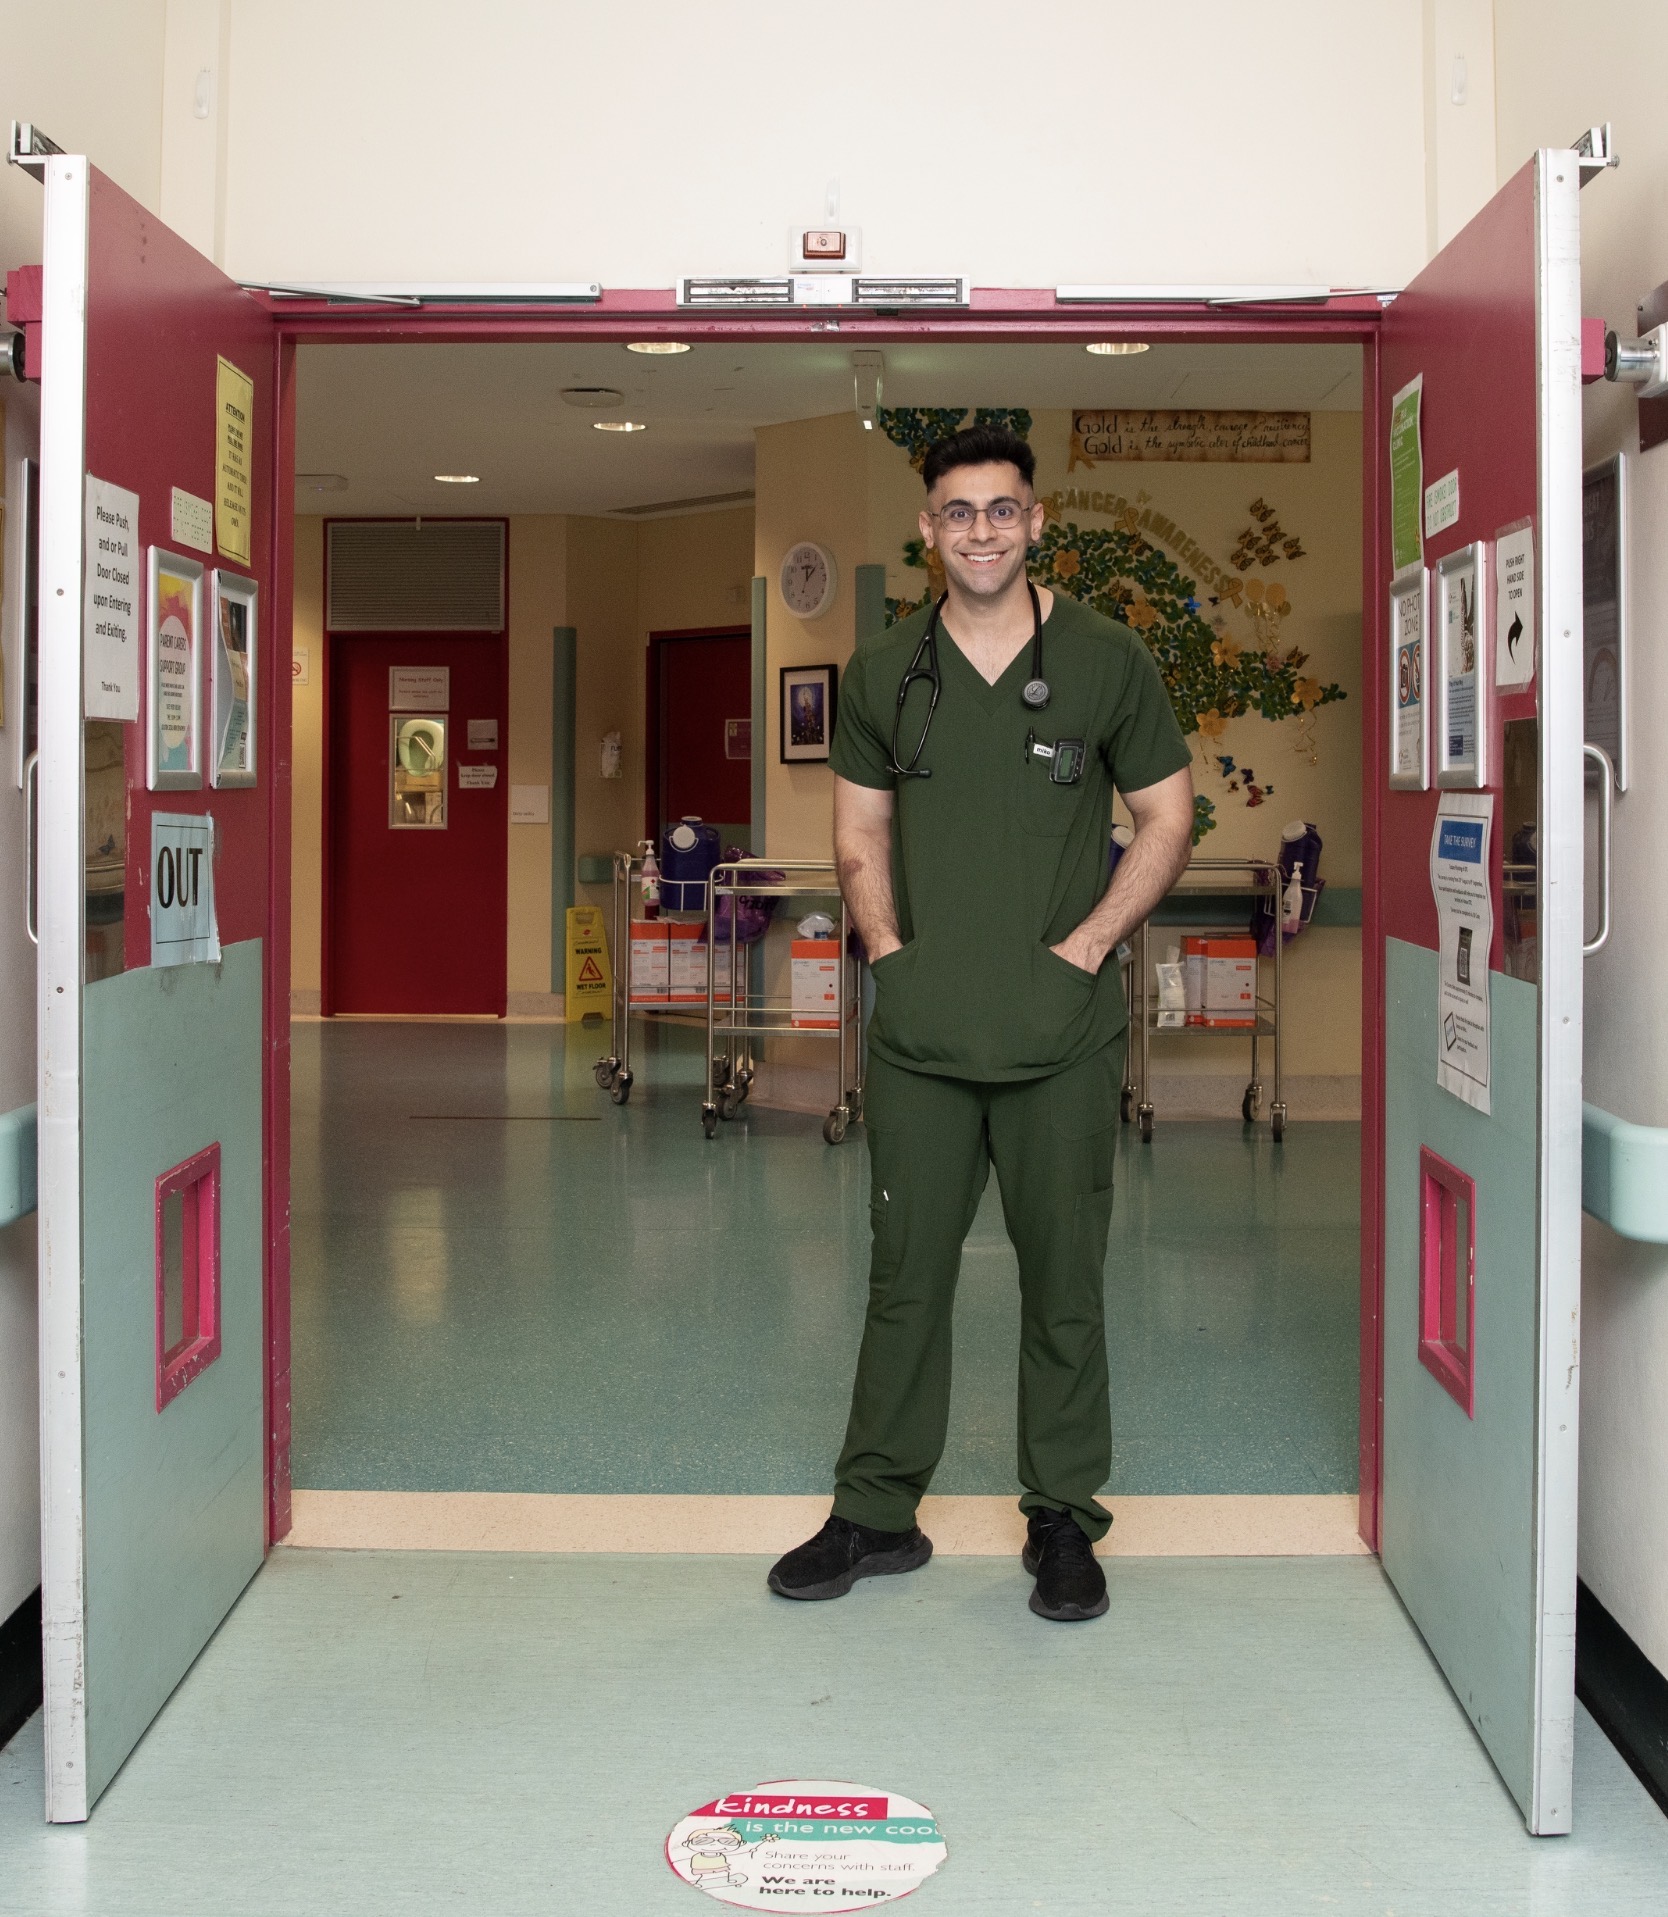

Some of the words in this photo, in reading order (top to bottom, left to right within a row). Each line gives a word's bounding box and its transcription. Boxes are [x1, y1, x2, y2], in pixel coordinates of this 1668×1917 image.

[1075, 415, 1118, 434] Gold
[1125, 421, 1135, 433] is
[1140, 417, 1159, 432] the
[1084, 435, 1122, 455] Gold
[1129, 440, 1139, 450] is
[1145, 436, 1163, 450] the
[1052, 488, 1128, 517] CANCER
[97, 506, 114, 525] Please
[116, 513, 129, 532] Push,
[99, 537, 109, 551] and
[111, 542, 117, 553] or
[118, 542, 128, 557] Pull
[1138, 508, 1231, 593] AWARENESS
[1506, 557, 1514, 568] PUSH
[1515, 554, 1524, 565] RIGHT
[97, 563, 111, 580] Door
[112, 568, 129, 585] Closed
[1507, 573, 1516, 584] HAND
[1512, 588, 1522, 599] OPEN
[94, 594, 108, 608] upon
[109, 595, 131, 616] Entering
[1399, 600, 1406, 617] NO
[1407, 593, 1420, 613] PHOT
[96, 621, 107, 636] and
[1404, 615, 1418, 636] ZONE
[160, 634, 173, 649] PARENT
[174, 636, 186, 651] CARERS
[160, 660, 175, 674] SUPPORT
[175, 662, 185, 675] GROUP
[101, 681, 112, 692] Thank
[1444, 834, 1453, 845] TAKE
[1453, 836, 1461, 845] THE
[1461, 837, 1477, 848] SURVEY
[157, 846, 203, 909] OUT
[575, 947, 602, 955] WARNING
[589, 982, 606, 990] FLOOR
[715, 1797, 868, 1816] kindness
[746, 1821, 764, 1832] is
[773, 1821, 814, 1833] the
[823, 1824, 877, 1834] new
[765, 1851, 809, 1860] Share
[814, 1853, 851, 1861] your
[763, 1862, 835, 1870] concerns
[841, 1862, 874, 1871] with
[880, 1863, 915, 1871] staff.
[762, 1876, 796, 1885] We
[759, 1886, 806, 1895] here
[813, 1887, 835, 1896] to
[841, 1888, 891, 1898] help.
